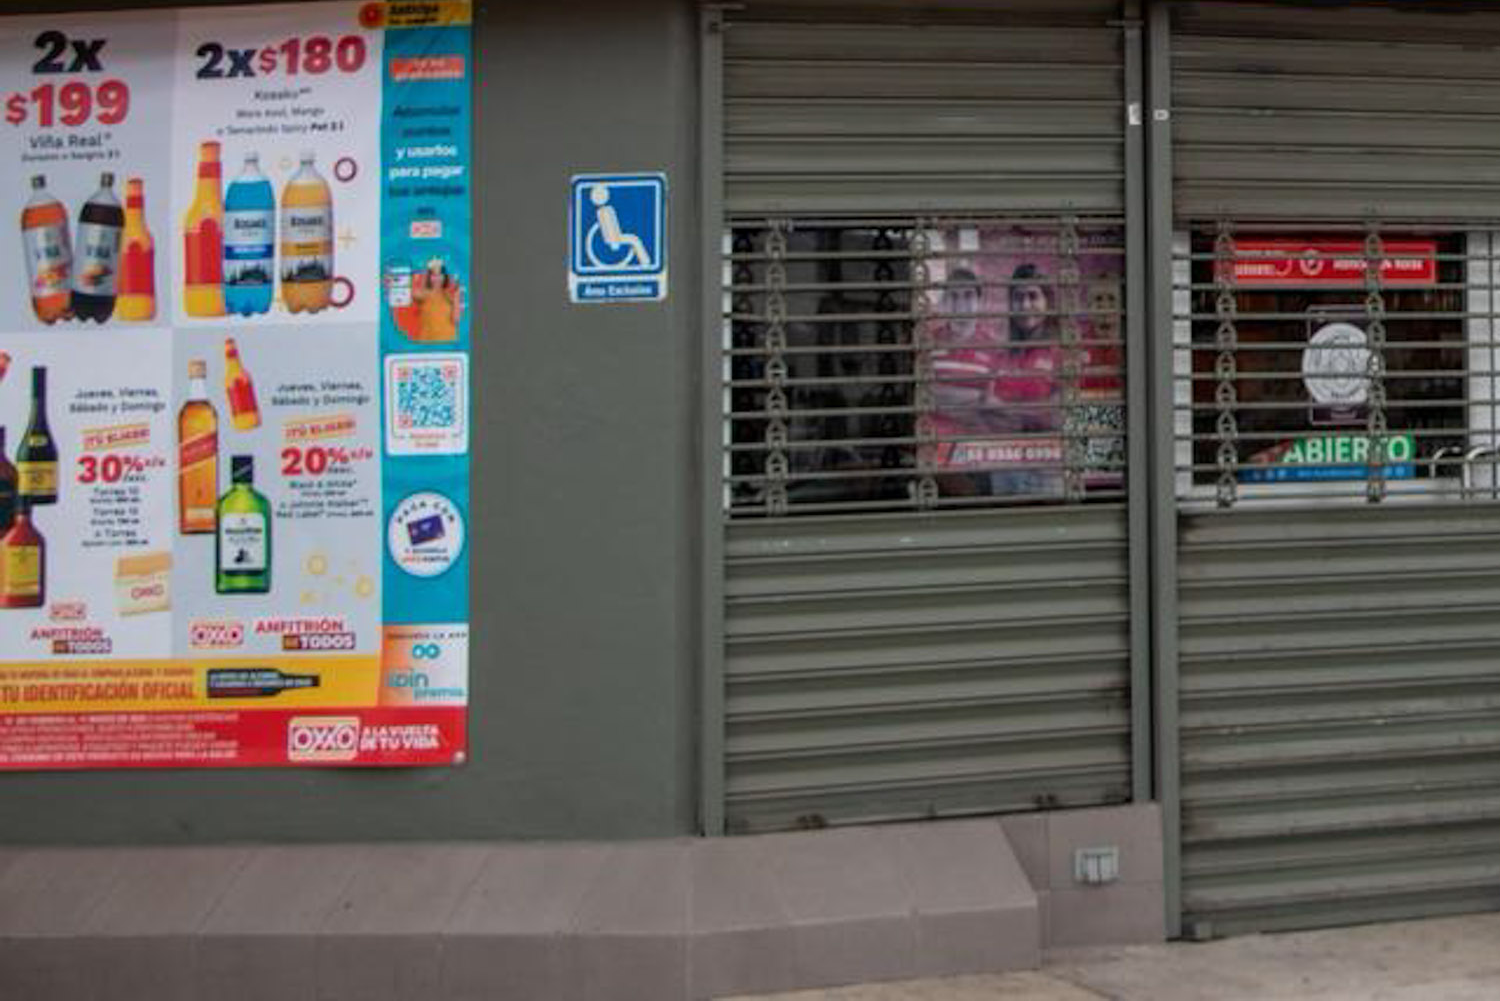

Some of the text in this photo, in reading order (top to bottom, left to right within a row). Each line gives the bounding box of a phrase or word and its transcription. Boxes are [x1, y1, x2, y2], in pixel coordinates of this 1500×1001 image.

[33, 30, 107, 74] 2x
[5, 79, 131, 127] $199
[77, 455, 145, 483] 30%
[281, 446, 349, 476] 20%
[22, 682, 138, 702] IDENTIFICACIÓN
[143, 681, 194, 699] OFICIAL
[293, 726, 356, 750] OXXO
